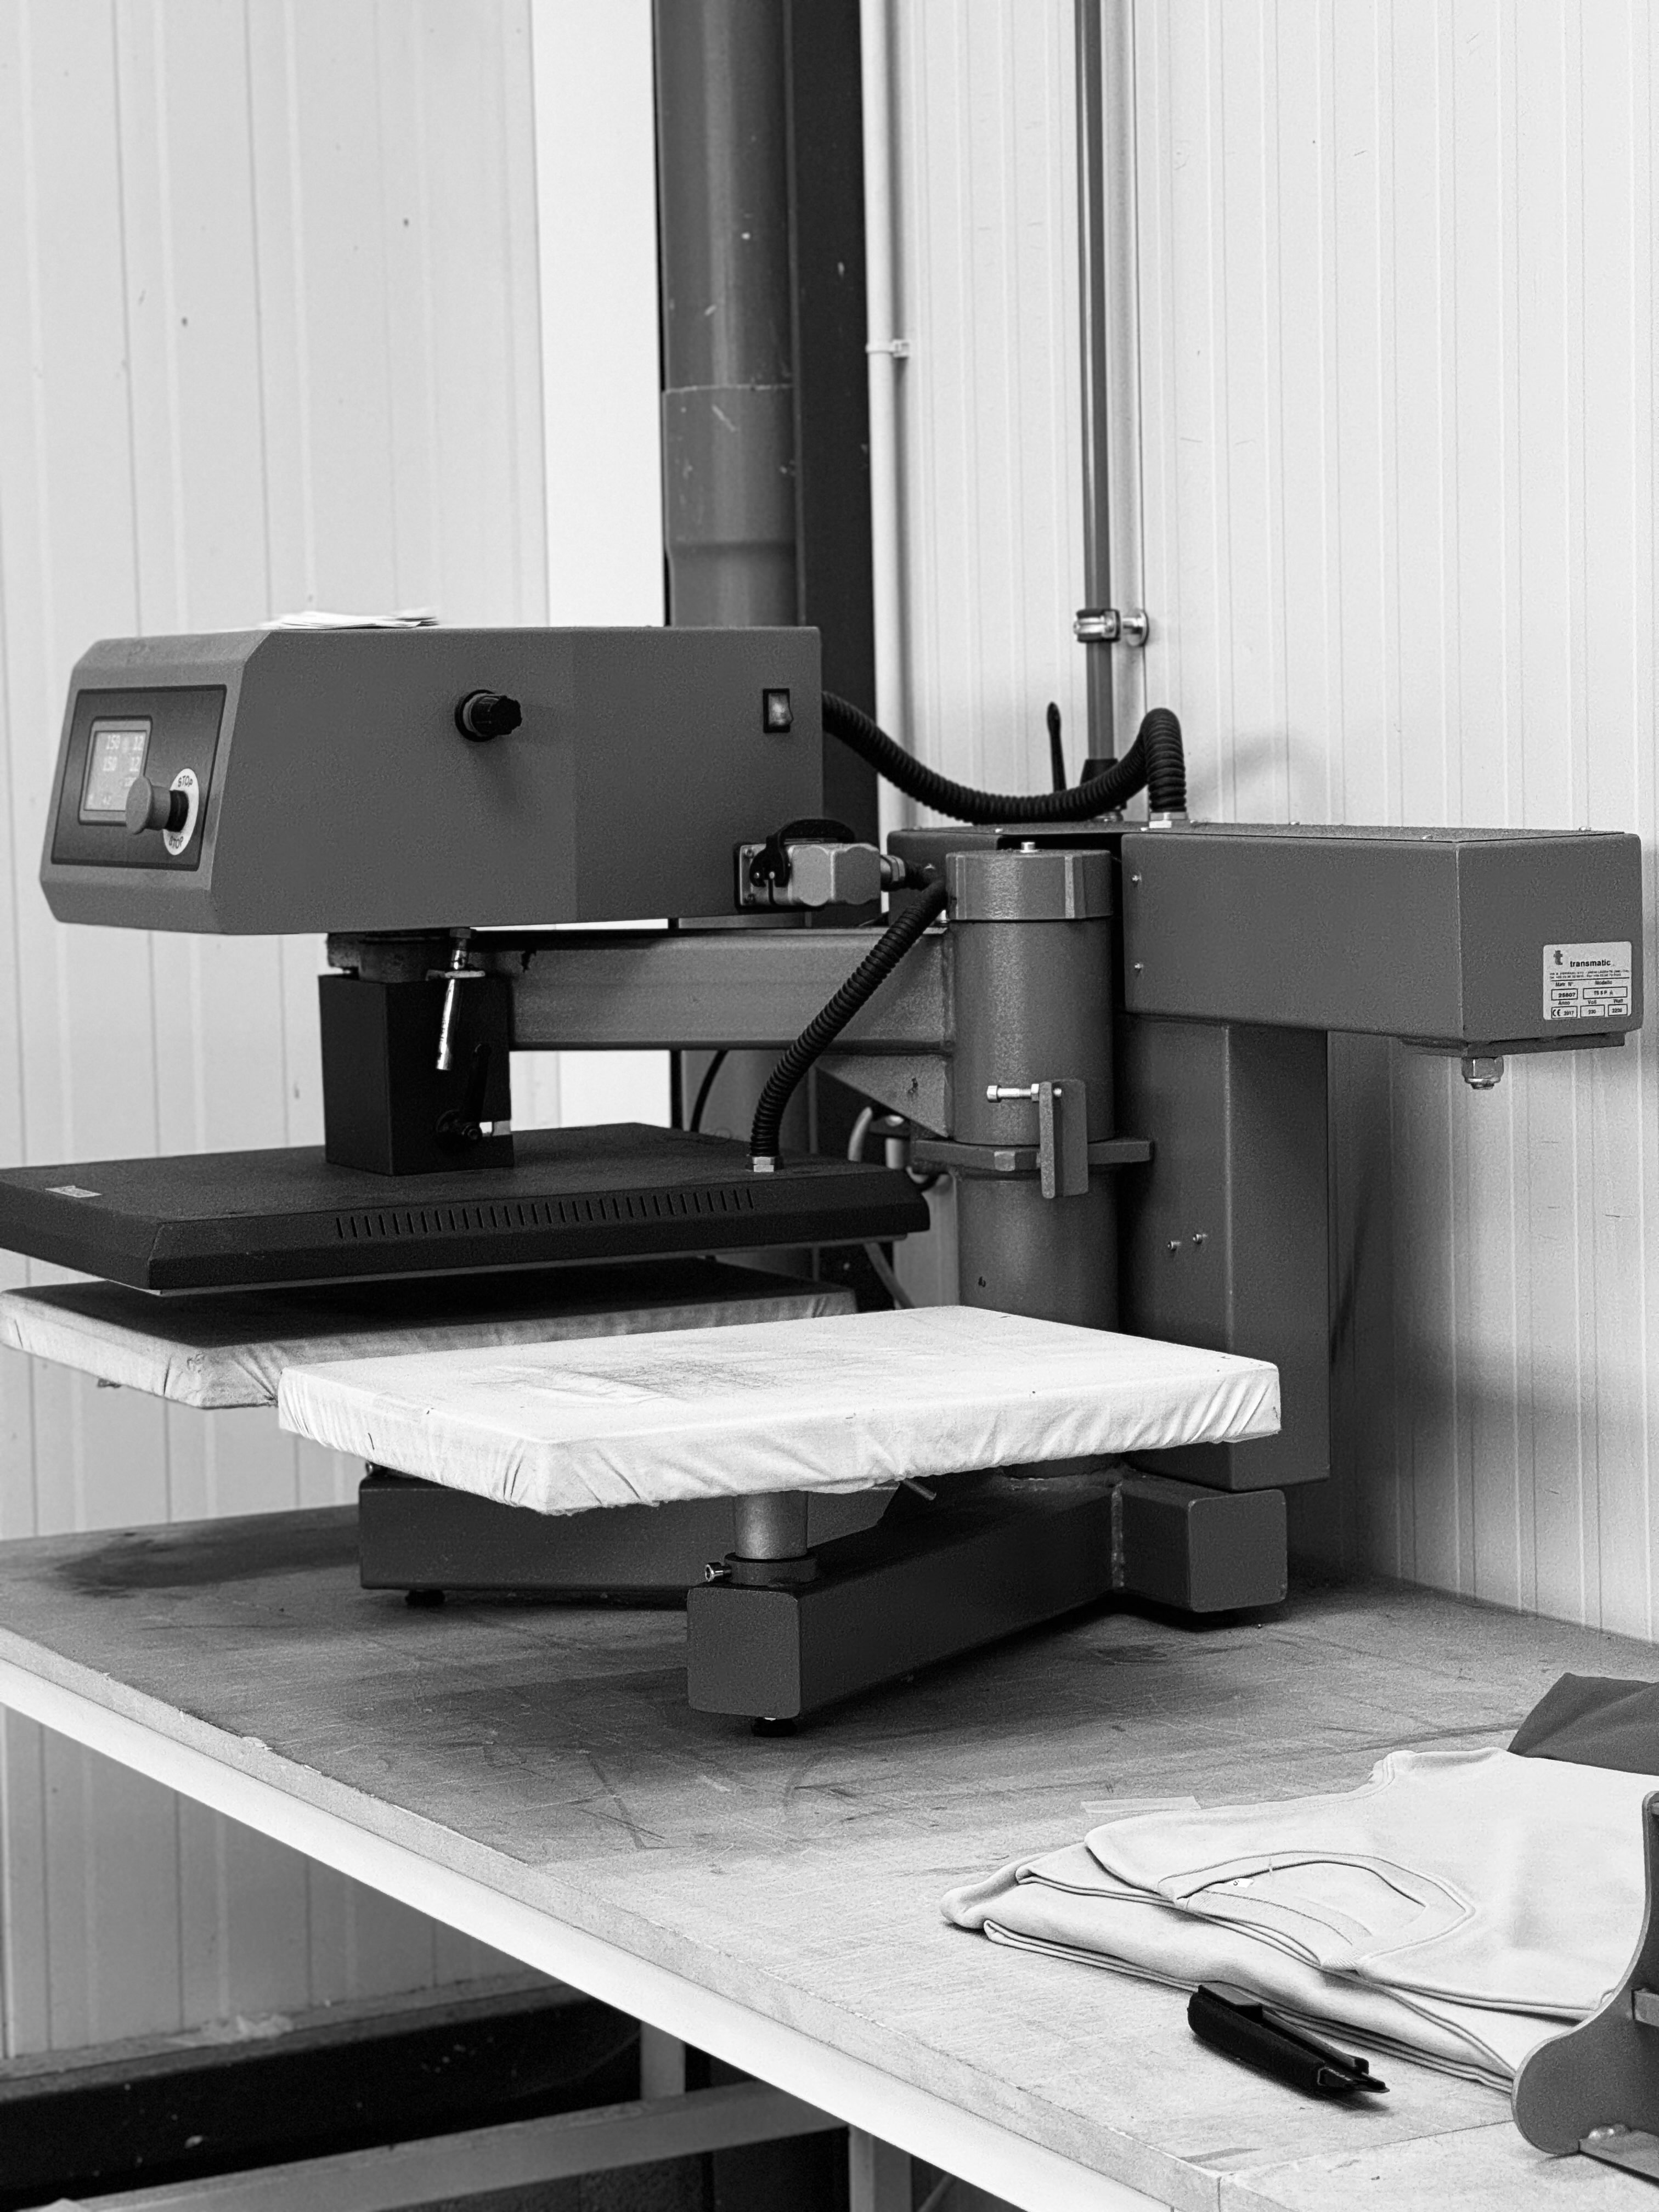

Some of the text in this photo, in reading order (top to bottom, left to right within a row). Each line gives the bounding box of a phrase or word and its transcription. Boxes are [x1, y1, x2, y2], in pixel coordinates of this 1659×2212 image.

[178, 775, 193, 787] STOP
[168, 836, 184, 849] STOP
[1570, 959, 1611, 967] transmatic
